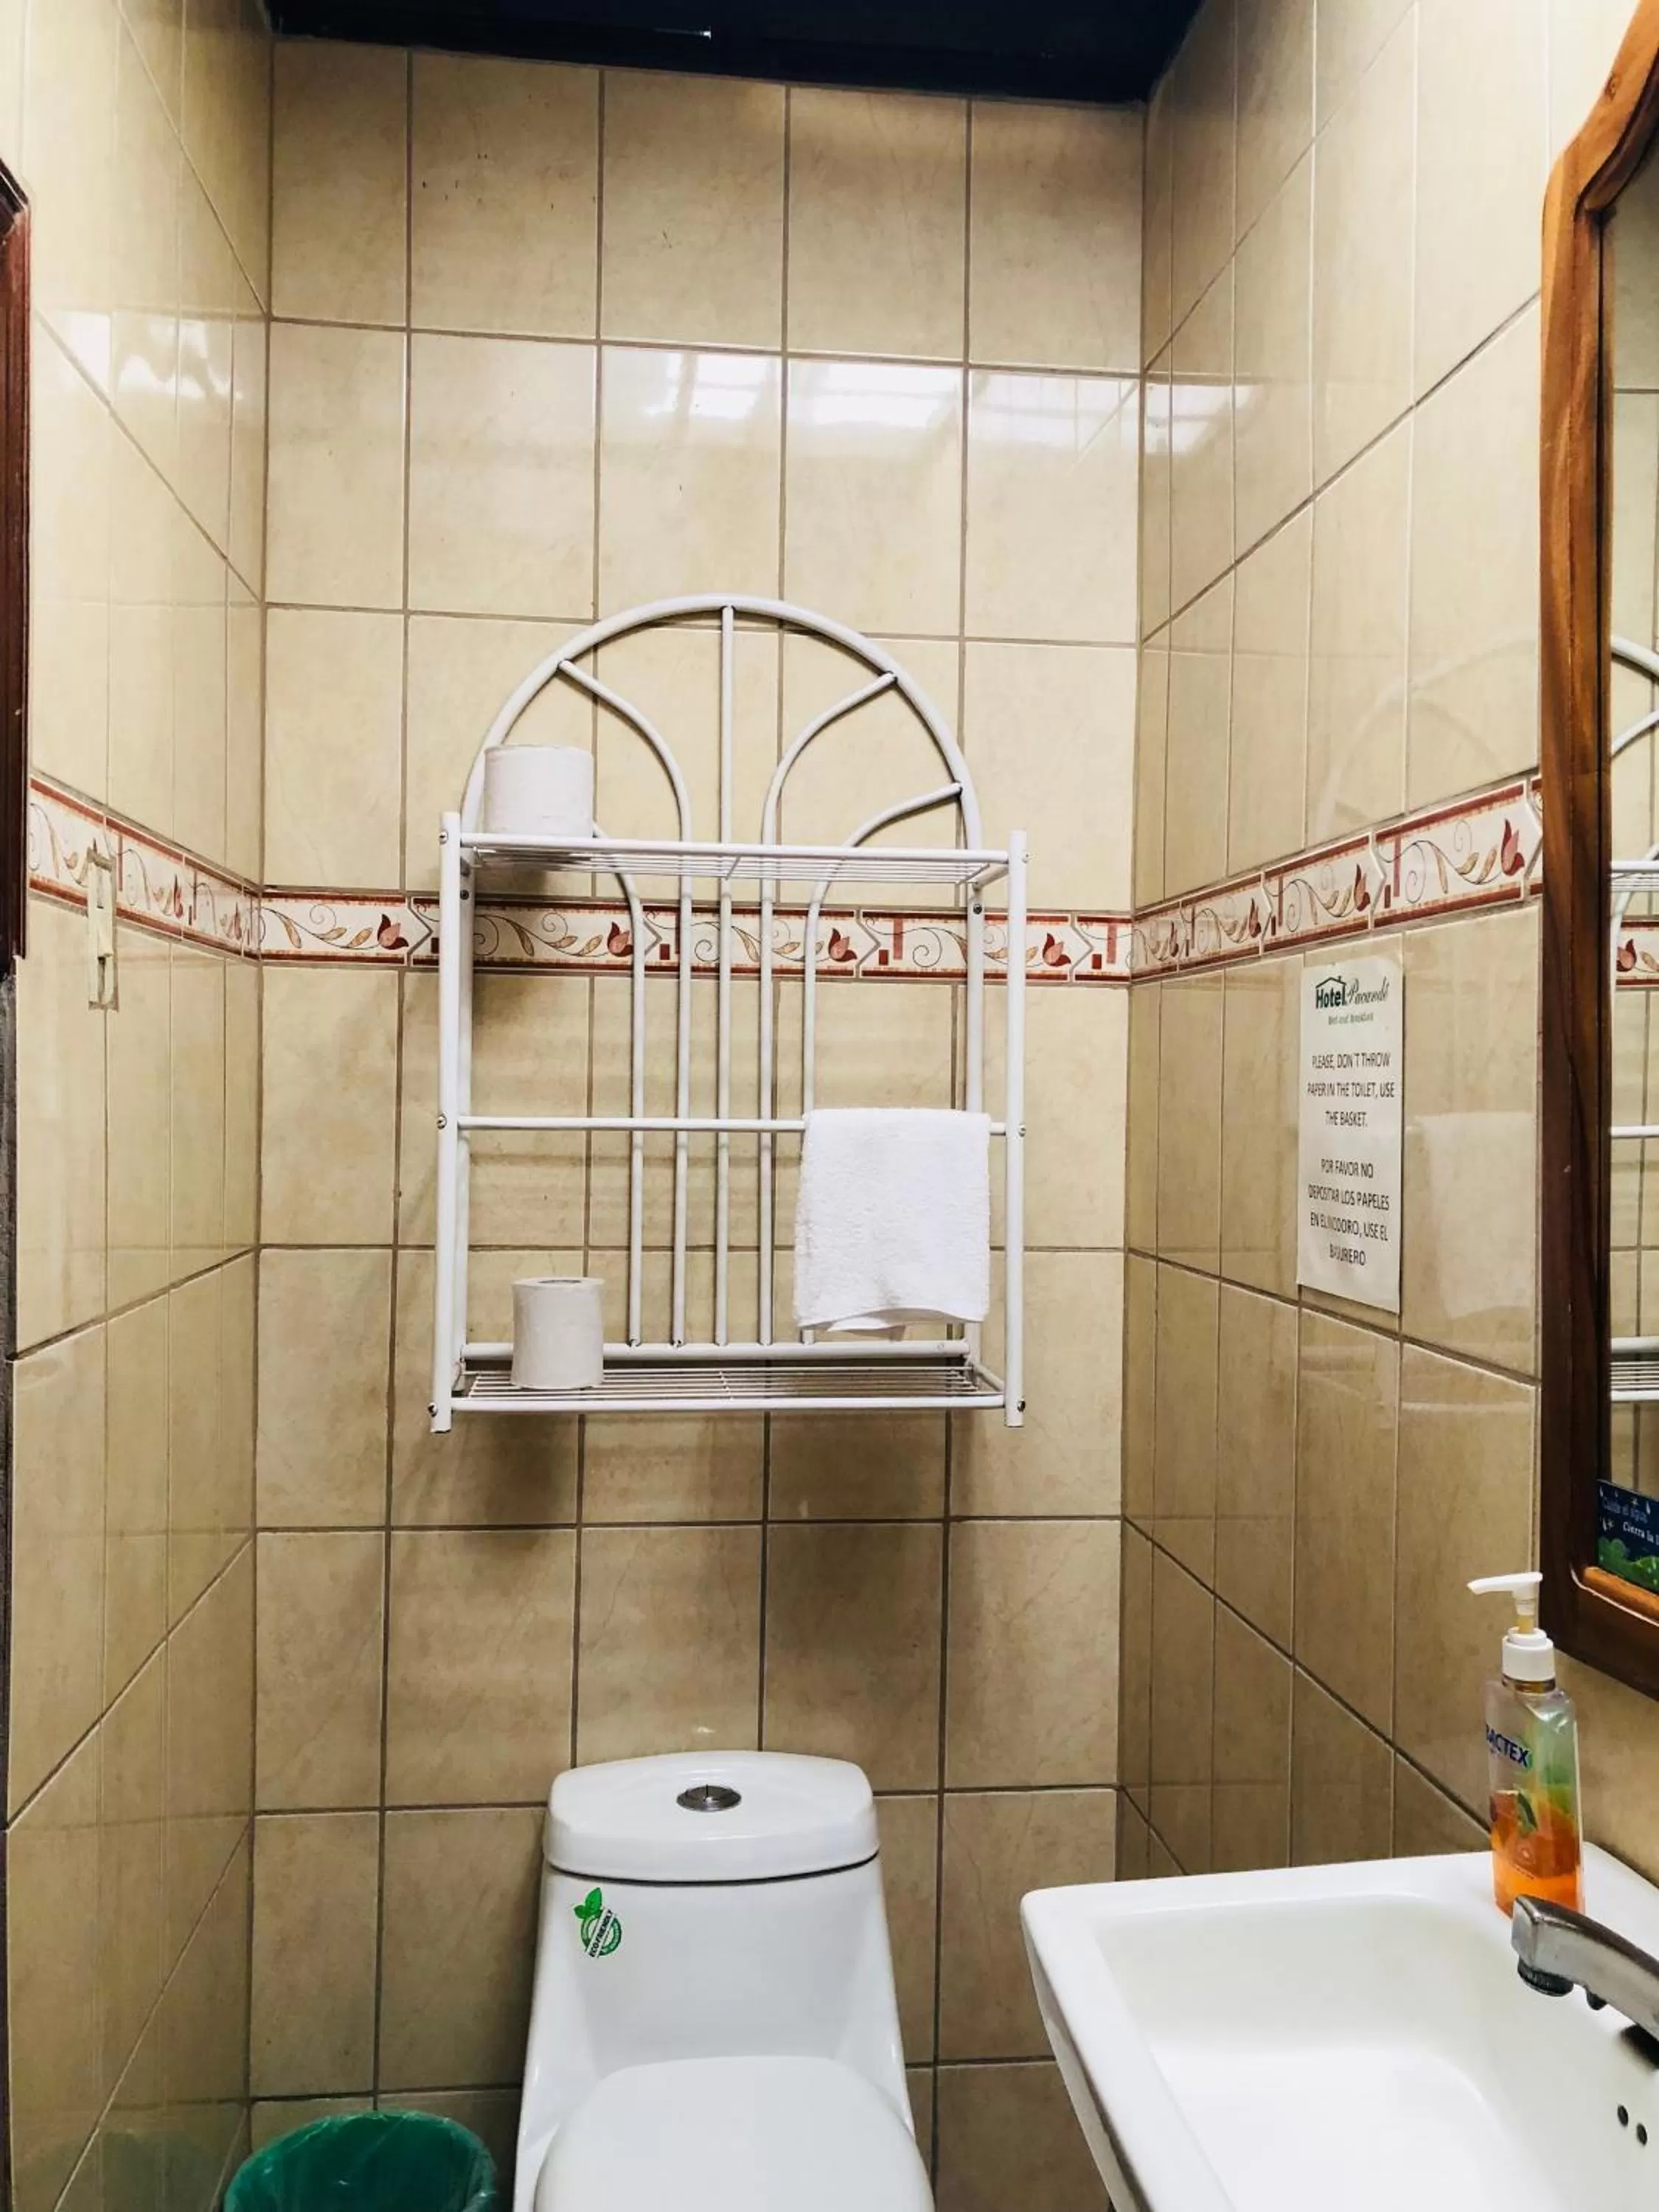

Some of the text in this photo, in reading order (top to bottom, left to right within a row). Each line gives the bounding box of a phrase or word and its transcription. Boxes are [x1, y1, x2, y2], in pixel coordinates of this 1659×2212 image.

[1316, 984, 1346, 1009] Hotel
[1312, 1054, 1335, 1071] PLEASE,
[1360, 1051, 1391, 1068] THROW
[1307, 1082, 1326, 1098] PAPER
[1327, 1082, 1335, 1098] IN
[1336, 1082, 1349, 1098] THE
[1380, 1082, 1395, 1098] USE
[1325, 1111, 1338, 1126] THE
[1321, 1158, 1373, 1178] POR FAVOR NO
[1341, 1189, 1355, 1206] LOS
[1357, 1191, 1389, 1211] PAPELES
[1310, 1211, 1319, 1227] EN
[1363, 1222, 1379, 1239] USE
[1380, 1225, 1388, 1242] EL
